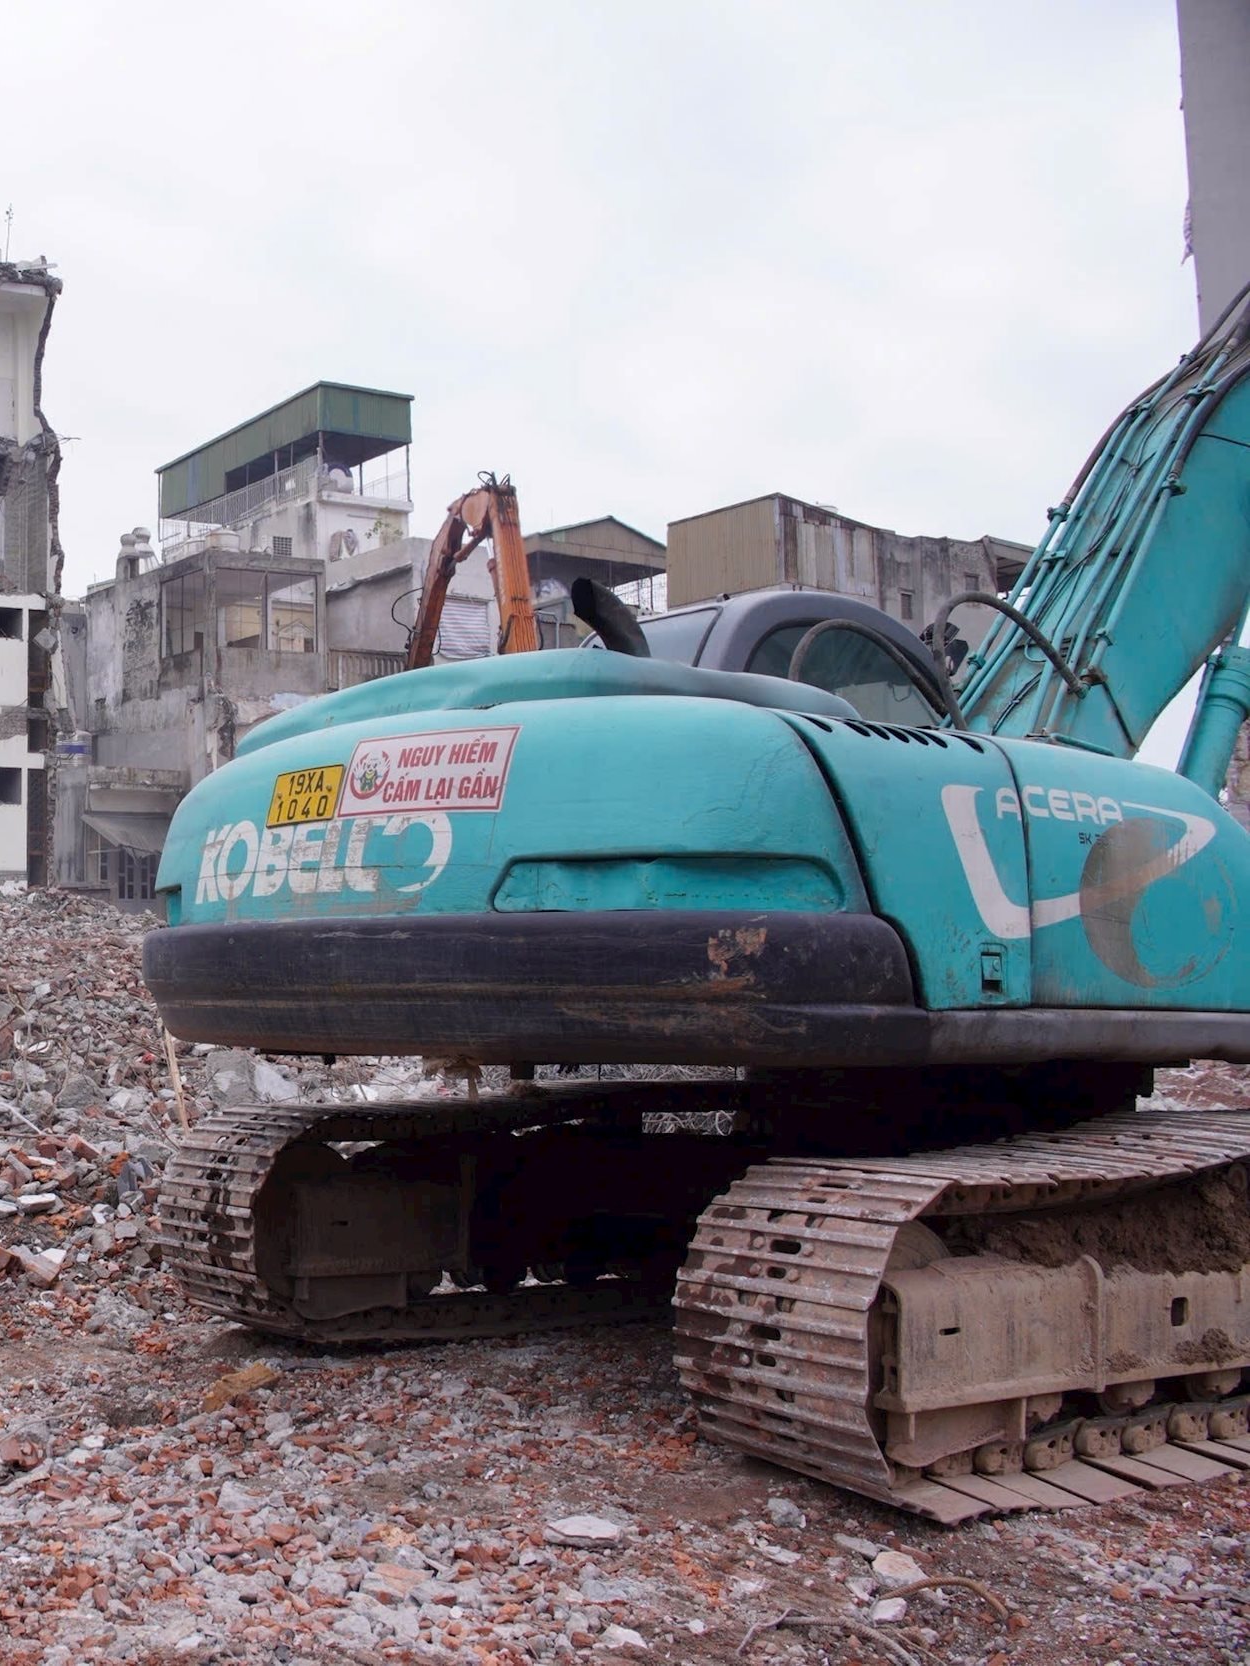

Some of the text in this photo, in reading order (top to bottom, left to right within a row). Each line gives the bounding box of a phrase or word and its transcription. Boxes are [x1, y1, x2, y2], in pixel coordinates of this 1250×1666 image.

[397, 734, 499, 769] NGUY HIỂM
[288, 770, 324, 797] 19XA
[382, 768, 500, 805] CẤM LẠI GẦN
[276, 795, 328, 823] 1040
[995, 785, 1124, 825] ACERA
